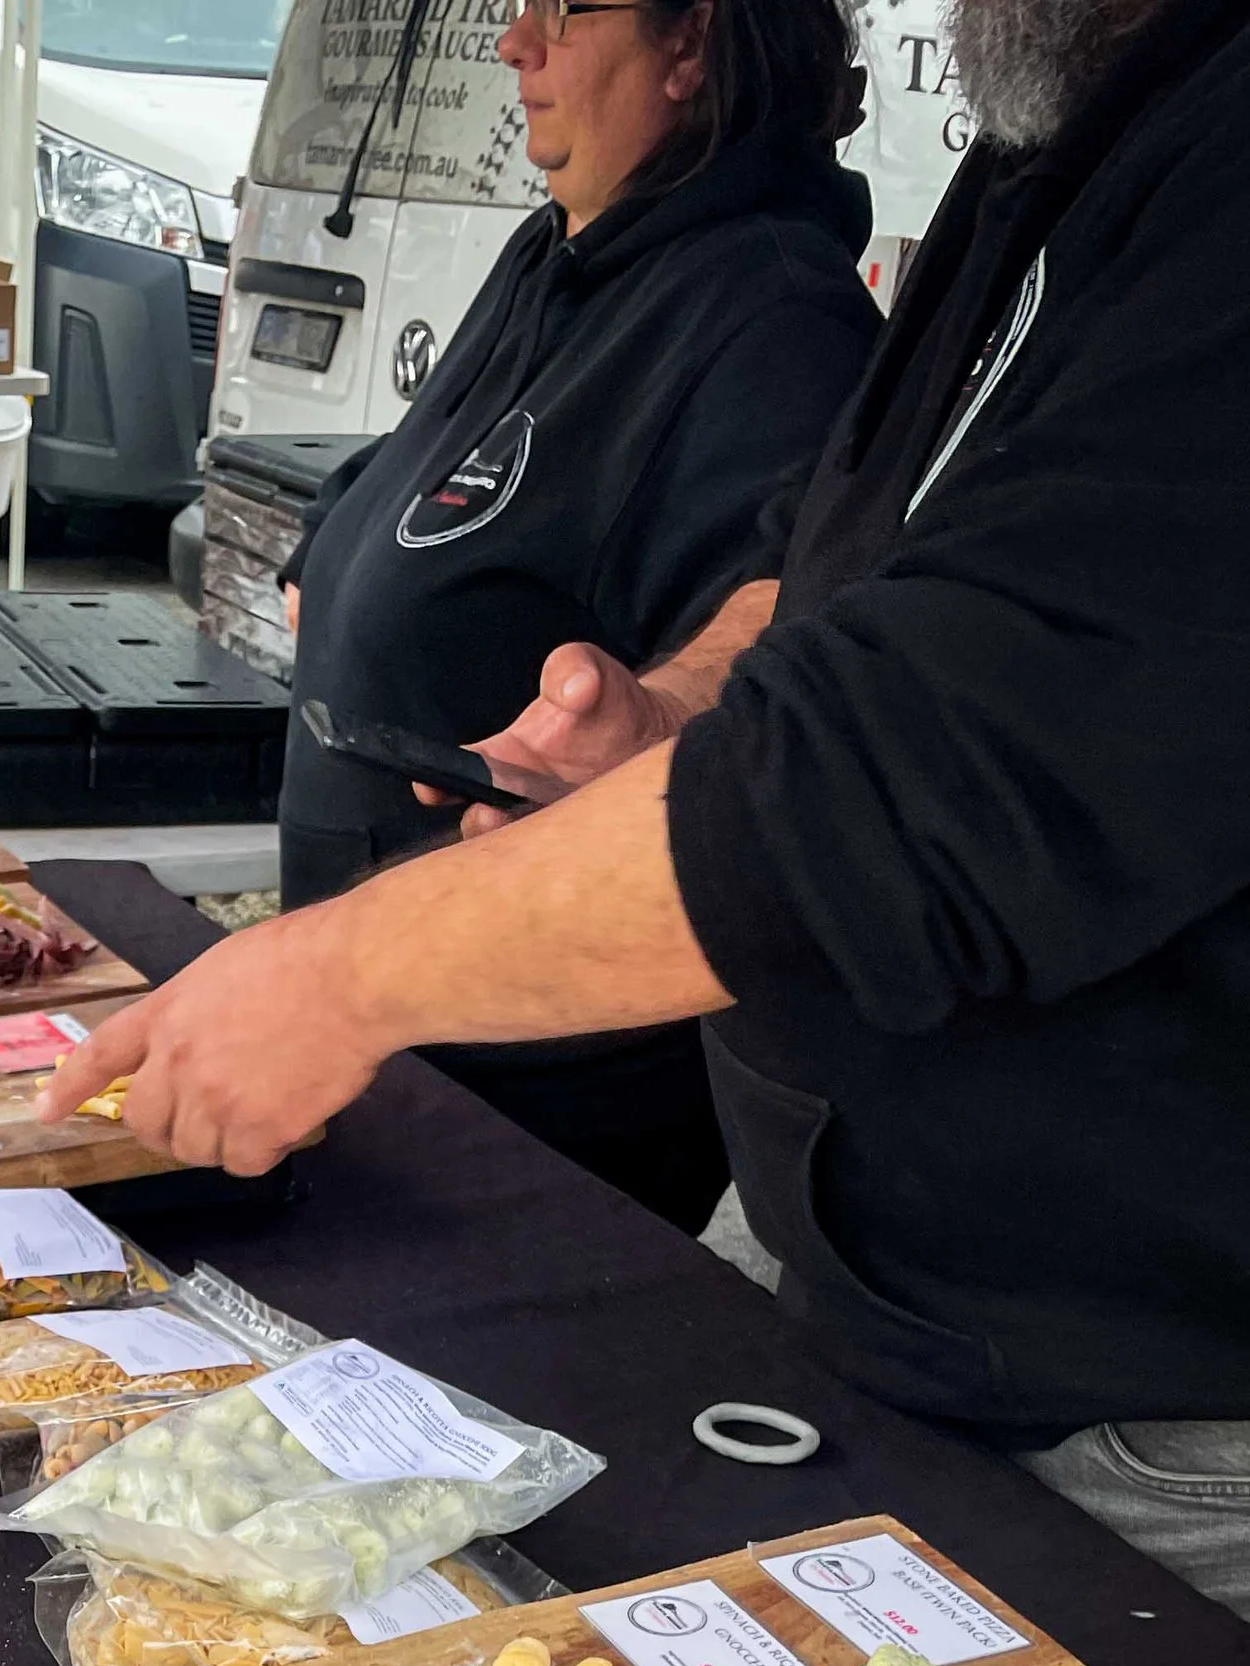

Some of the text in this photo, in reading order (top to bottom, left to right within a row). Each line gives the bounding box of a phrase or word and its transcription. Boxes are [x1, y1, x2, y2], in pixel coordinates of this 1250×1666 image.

[323, 28, 410, 59] GOURME
[712, 1599, 766, 1640] SPINACH
[974, 1614, 1019, 1644] PIZZA
